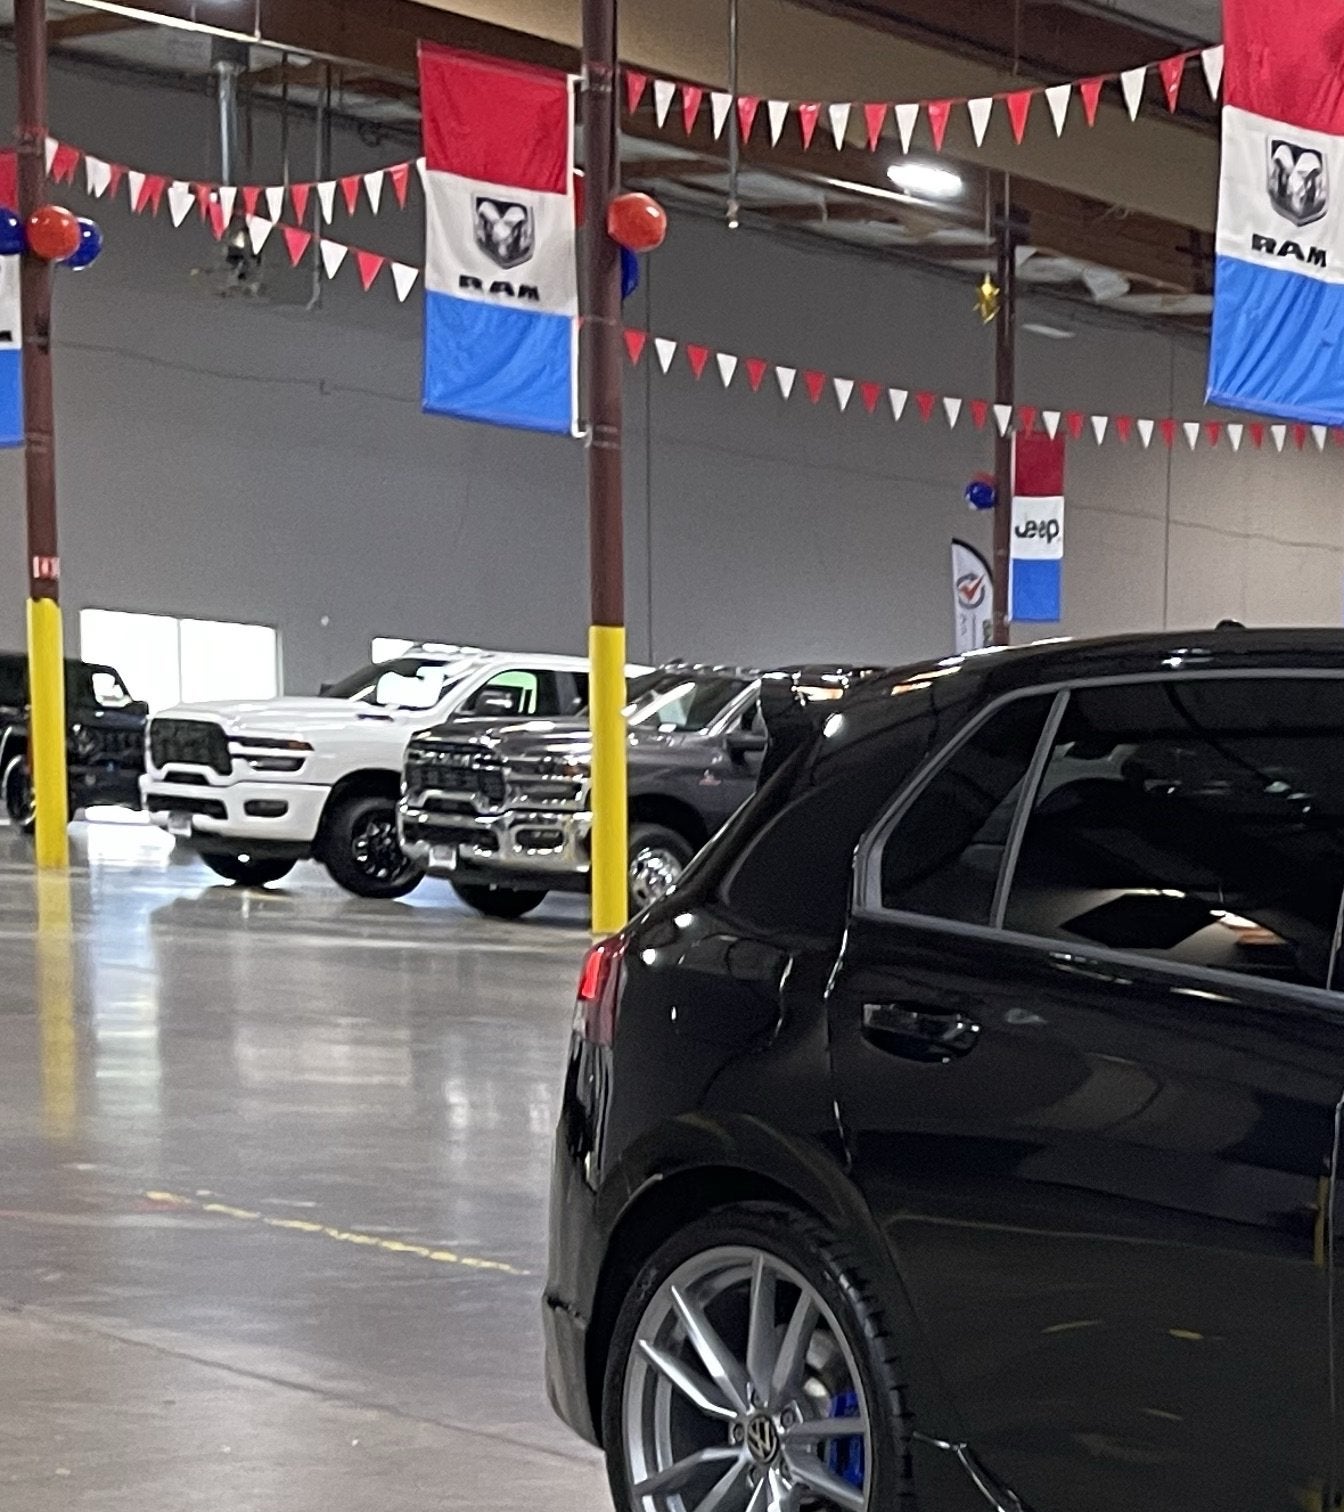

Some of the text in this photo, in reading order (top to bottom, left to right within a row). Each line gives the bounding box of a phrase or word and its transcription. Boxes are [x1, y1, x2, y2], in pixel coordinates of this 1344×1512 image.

[1251, 233, 1327, 268] RAM
[459, 274, 540, 301] RAM
[1015, 518, 1060, 544] Jeep
